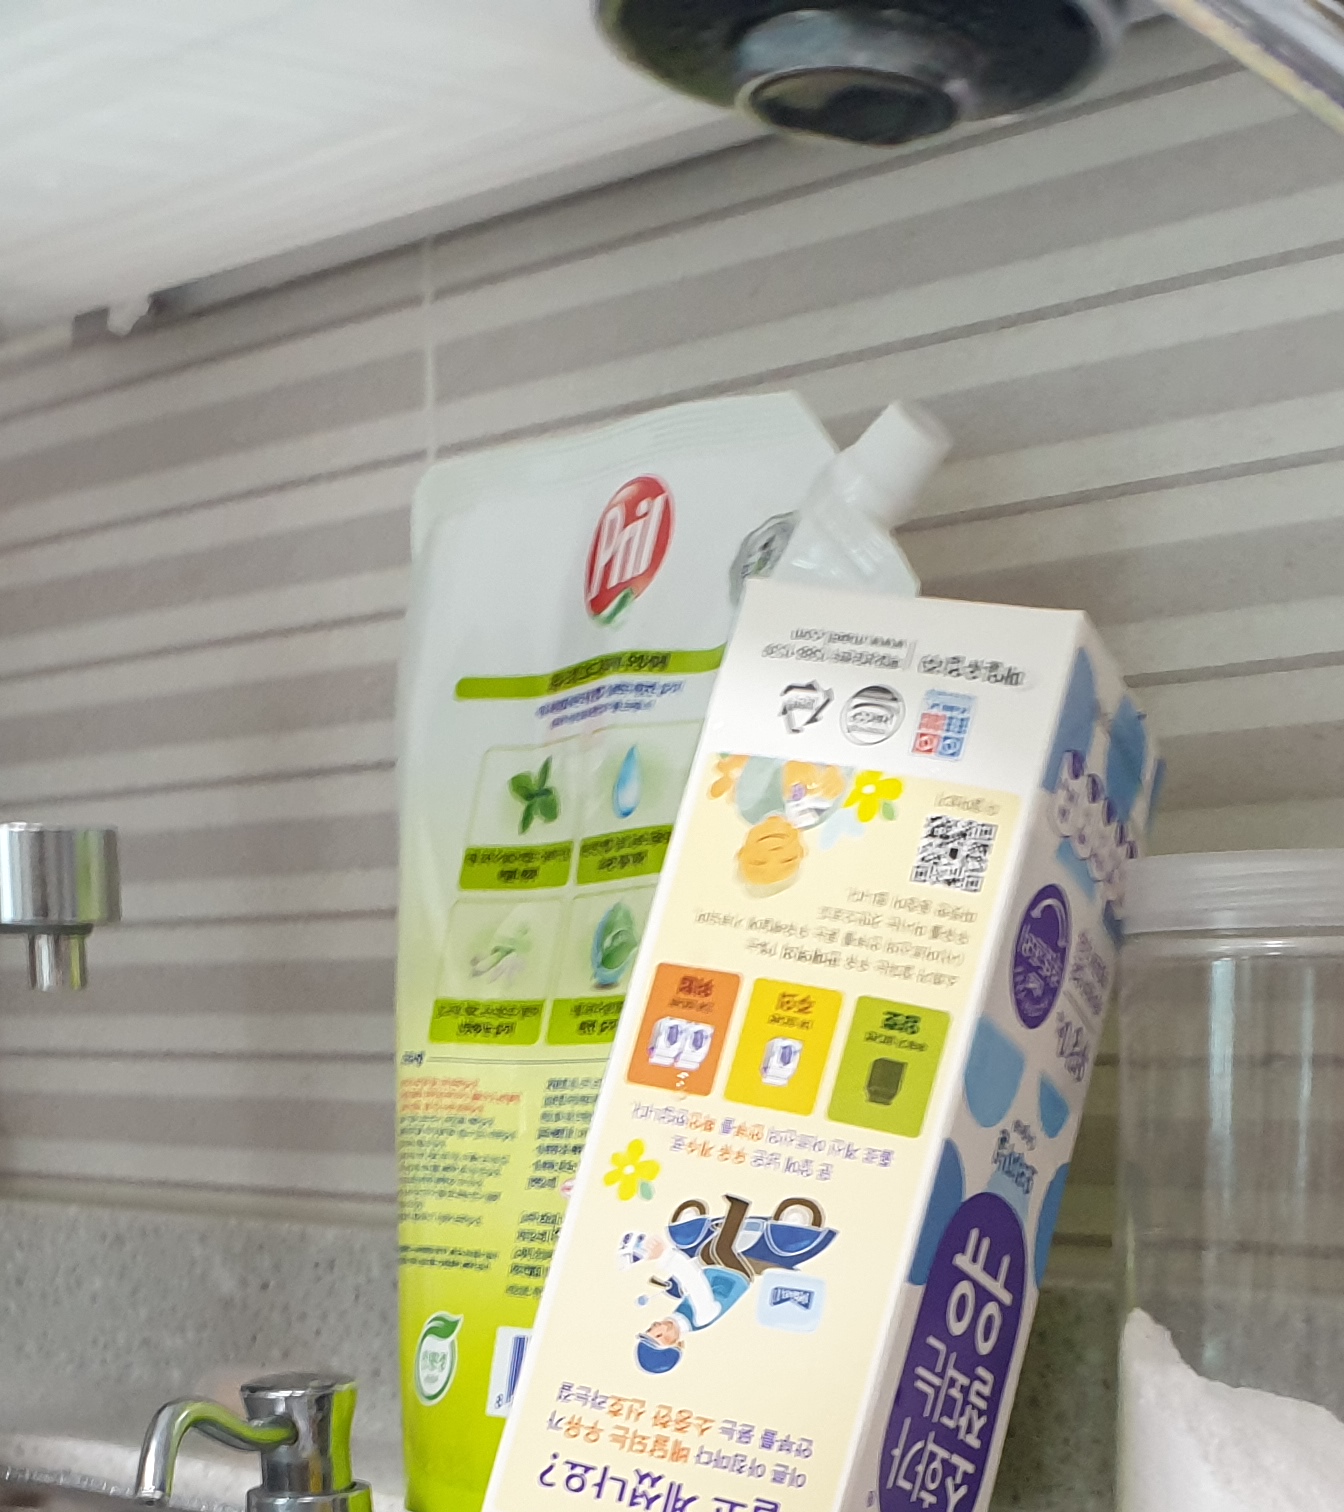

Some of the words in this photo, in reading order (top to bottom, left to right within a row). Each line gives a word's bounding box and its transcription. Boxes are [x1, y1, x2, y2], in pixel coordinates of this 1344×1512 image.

[589, 493, 669, 600] Pril
[945, 1226, 1014, 1356] 우유
[913, 1336, 995, 1448] 잘되는
[542, 1408, 606, 1445] 우유가
[649, 1403, 716, 1438] 소중한
[715, 1417, 757, 1447] 묻는
[604, 1423, 693, 1465] 배달되는
[756, 1427, 816, 1460] 안부를
[692, 1444, 769, 1480] 아침마다
[767, 1461, 809, 1490] 이른
